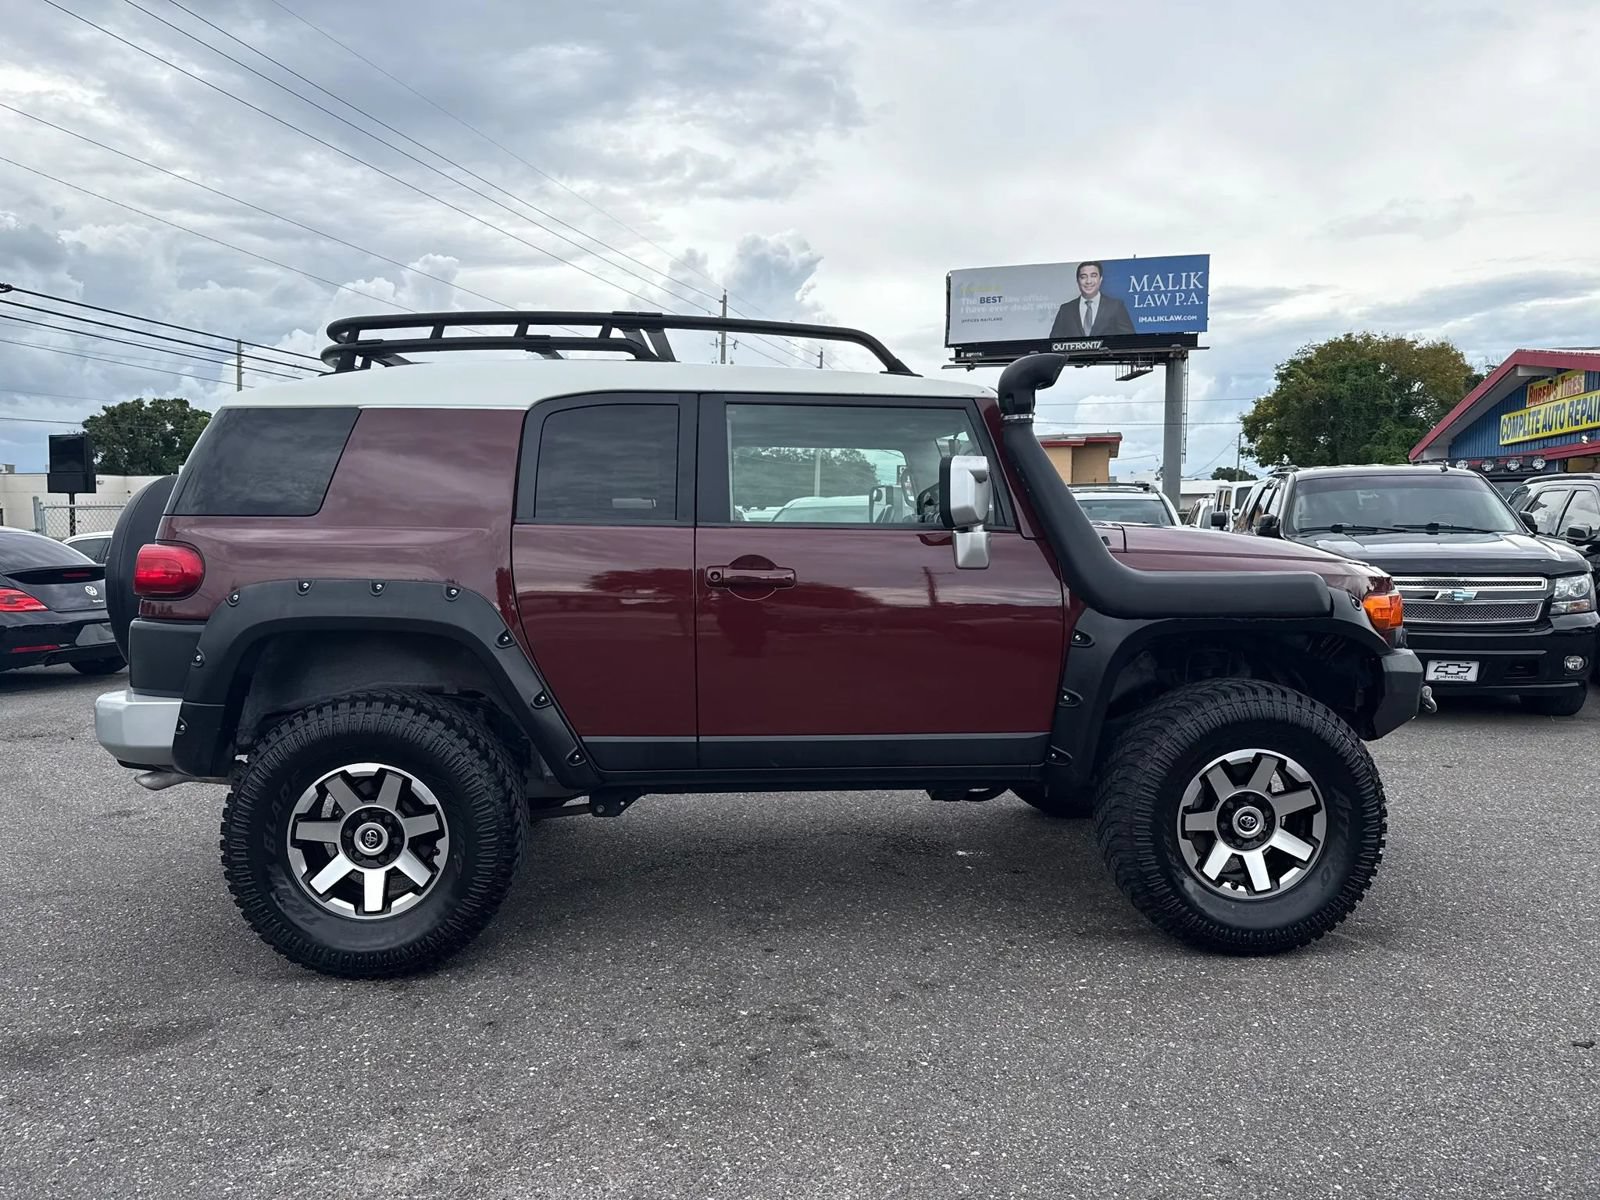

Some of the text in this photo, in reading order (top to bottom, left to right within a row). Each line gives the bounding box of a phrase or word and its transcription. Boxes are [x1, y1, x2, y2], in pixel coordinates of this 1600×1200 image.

[1128, 271, 1204, 293] MALIK
[979, 295, 1003, 304] BEST
[1134, 291, 1204, 308] LAW P.A.
[1501, 408, 1542, 441] COMPLETE
[1542, 402, 1567, 433] AUTO
